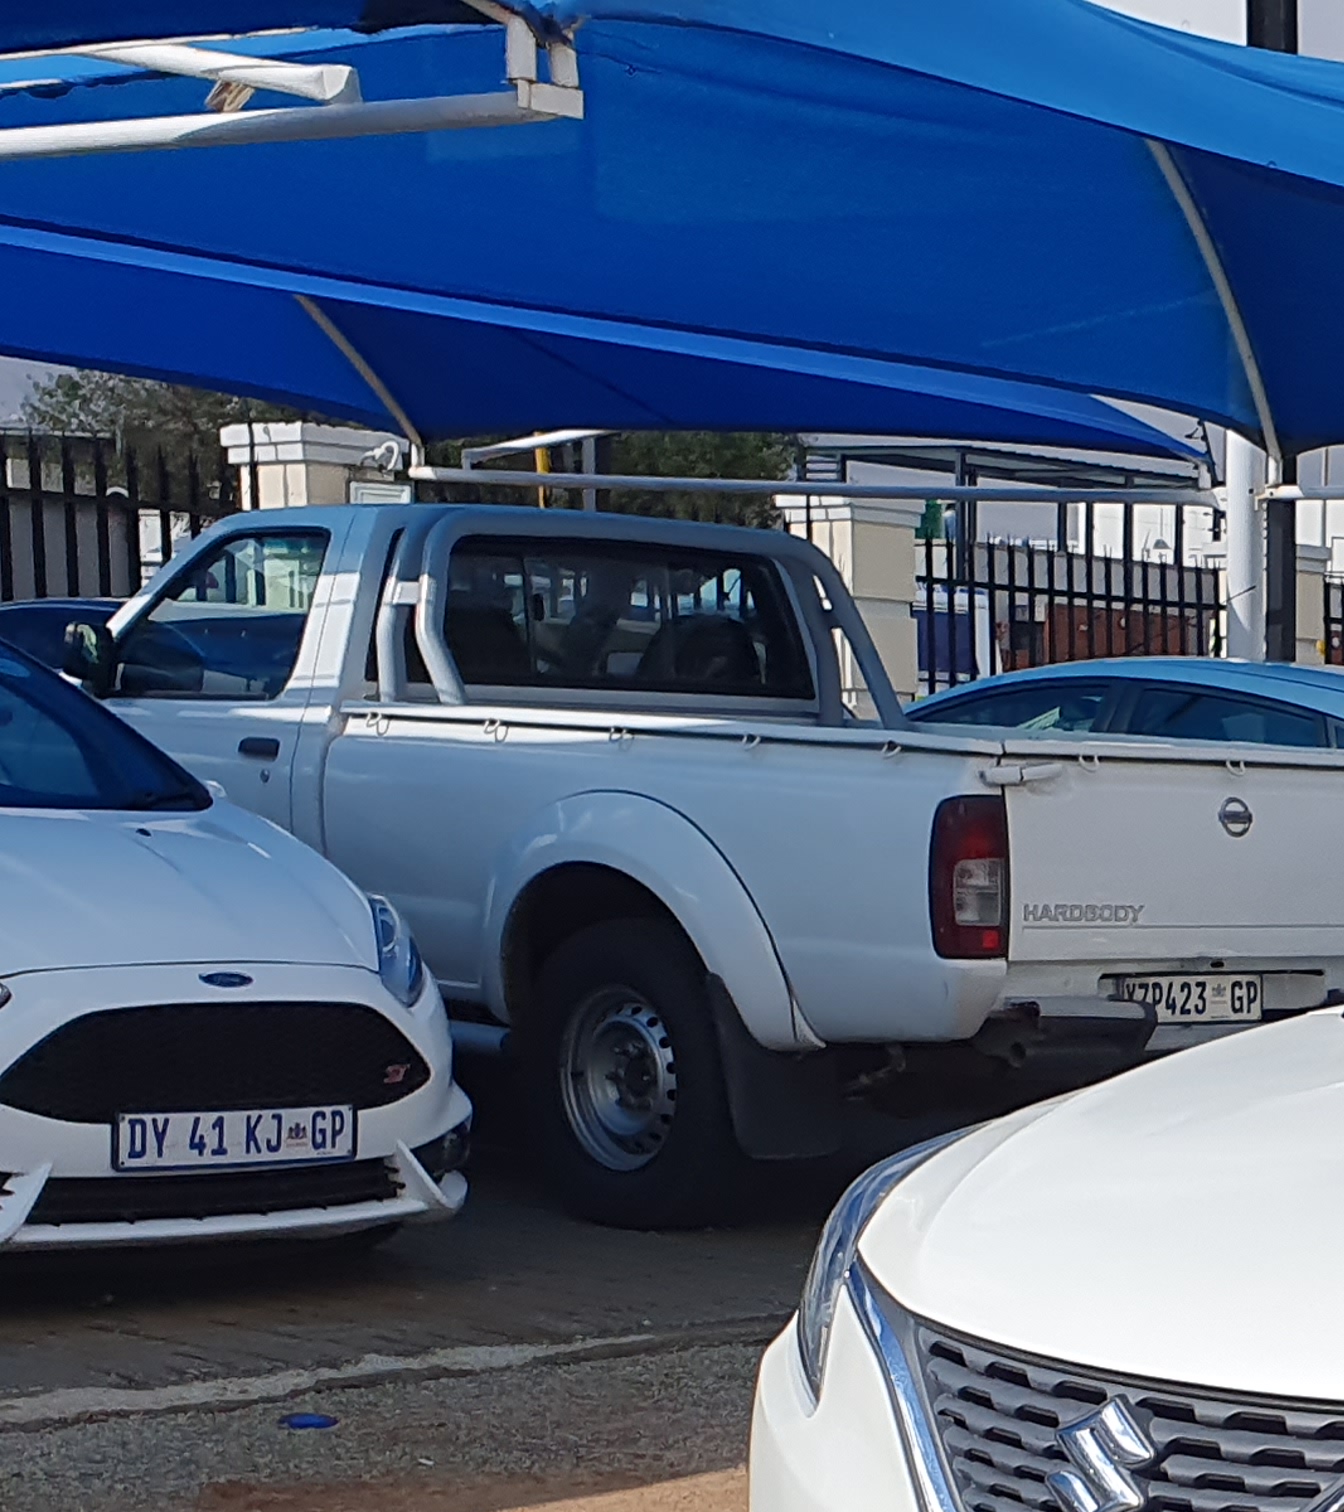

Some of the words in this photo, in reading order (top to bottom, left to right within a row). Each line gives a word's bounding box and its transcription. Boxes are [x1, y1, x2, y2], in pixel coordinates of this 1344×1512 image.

[1023, 903, 1145, 922] HARDBODY
[1230, 980, 1258, 1014] GP
[127, 1117, 170, 1159] DY
[189, 1115, 228, 1157] 41
[244, 1113, 283, 1155] KJ
[311, 1109, 345, 1151] GP
